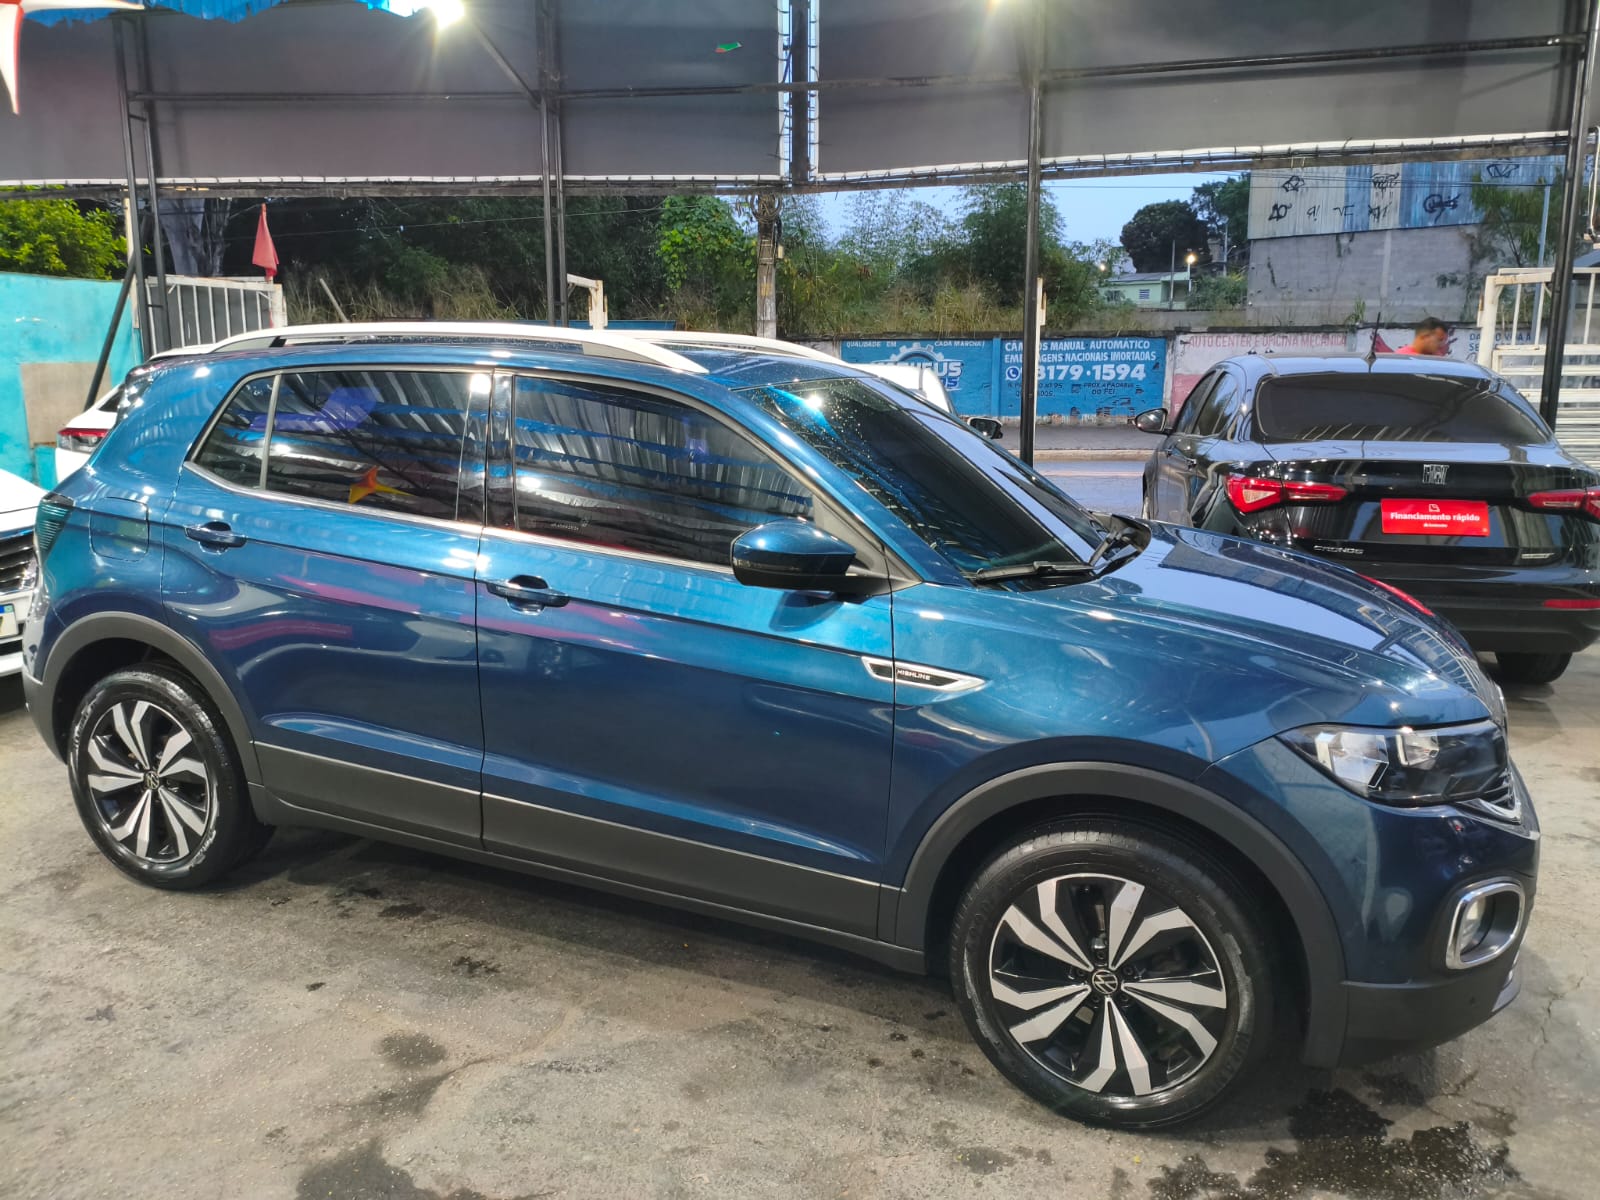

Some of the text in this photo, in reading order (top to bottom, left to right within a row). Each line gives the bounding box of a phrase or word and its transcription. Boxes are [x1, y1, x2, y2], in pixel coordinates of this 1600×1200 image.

[1050, 340, 1086, 351] MANUAL
[1064, 352, 1109, 363] NACIONAIS
[1390, 511, 1481, 523] Financiamento rápido
